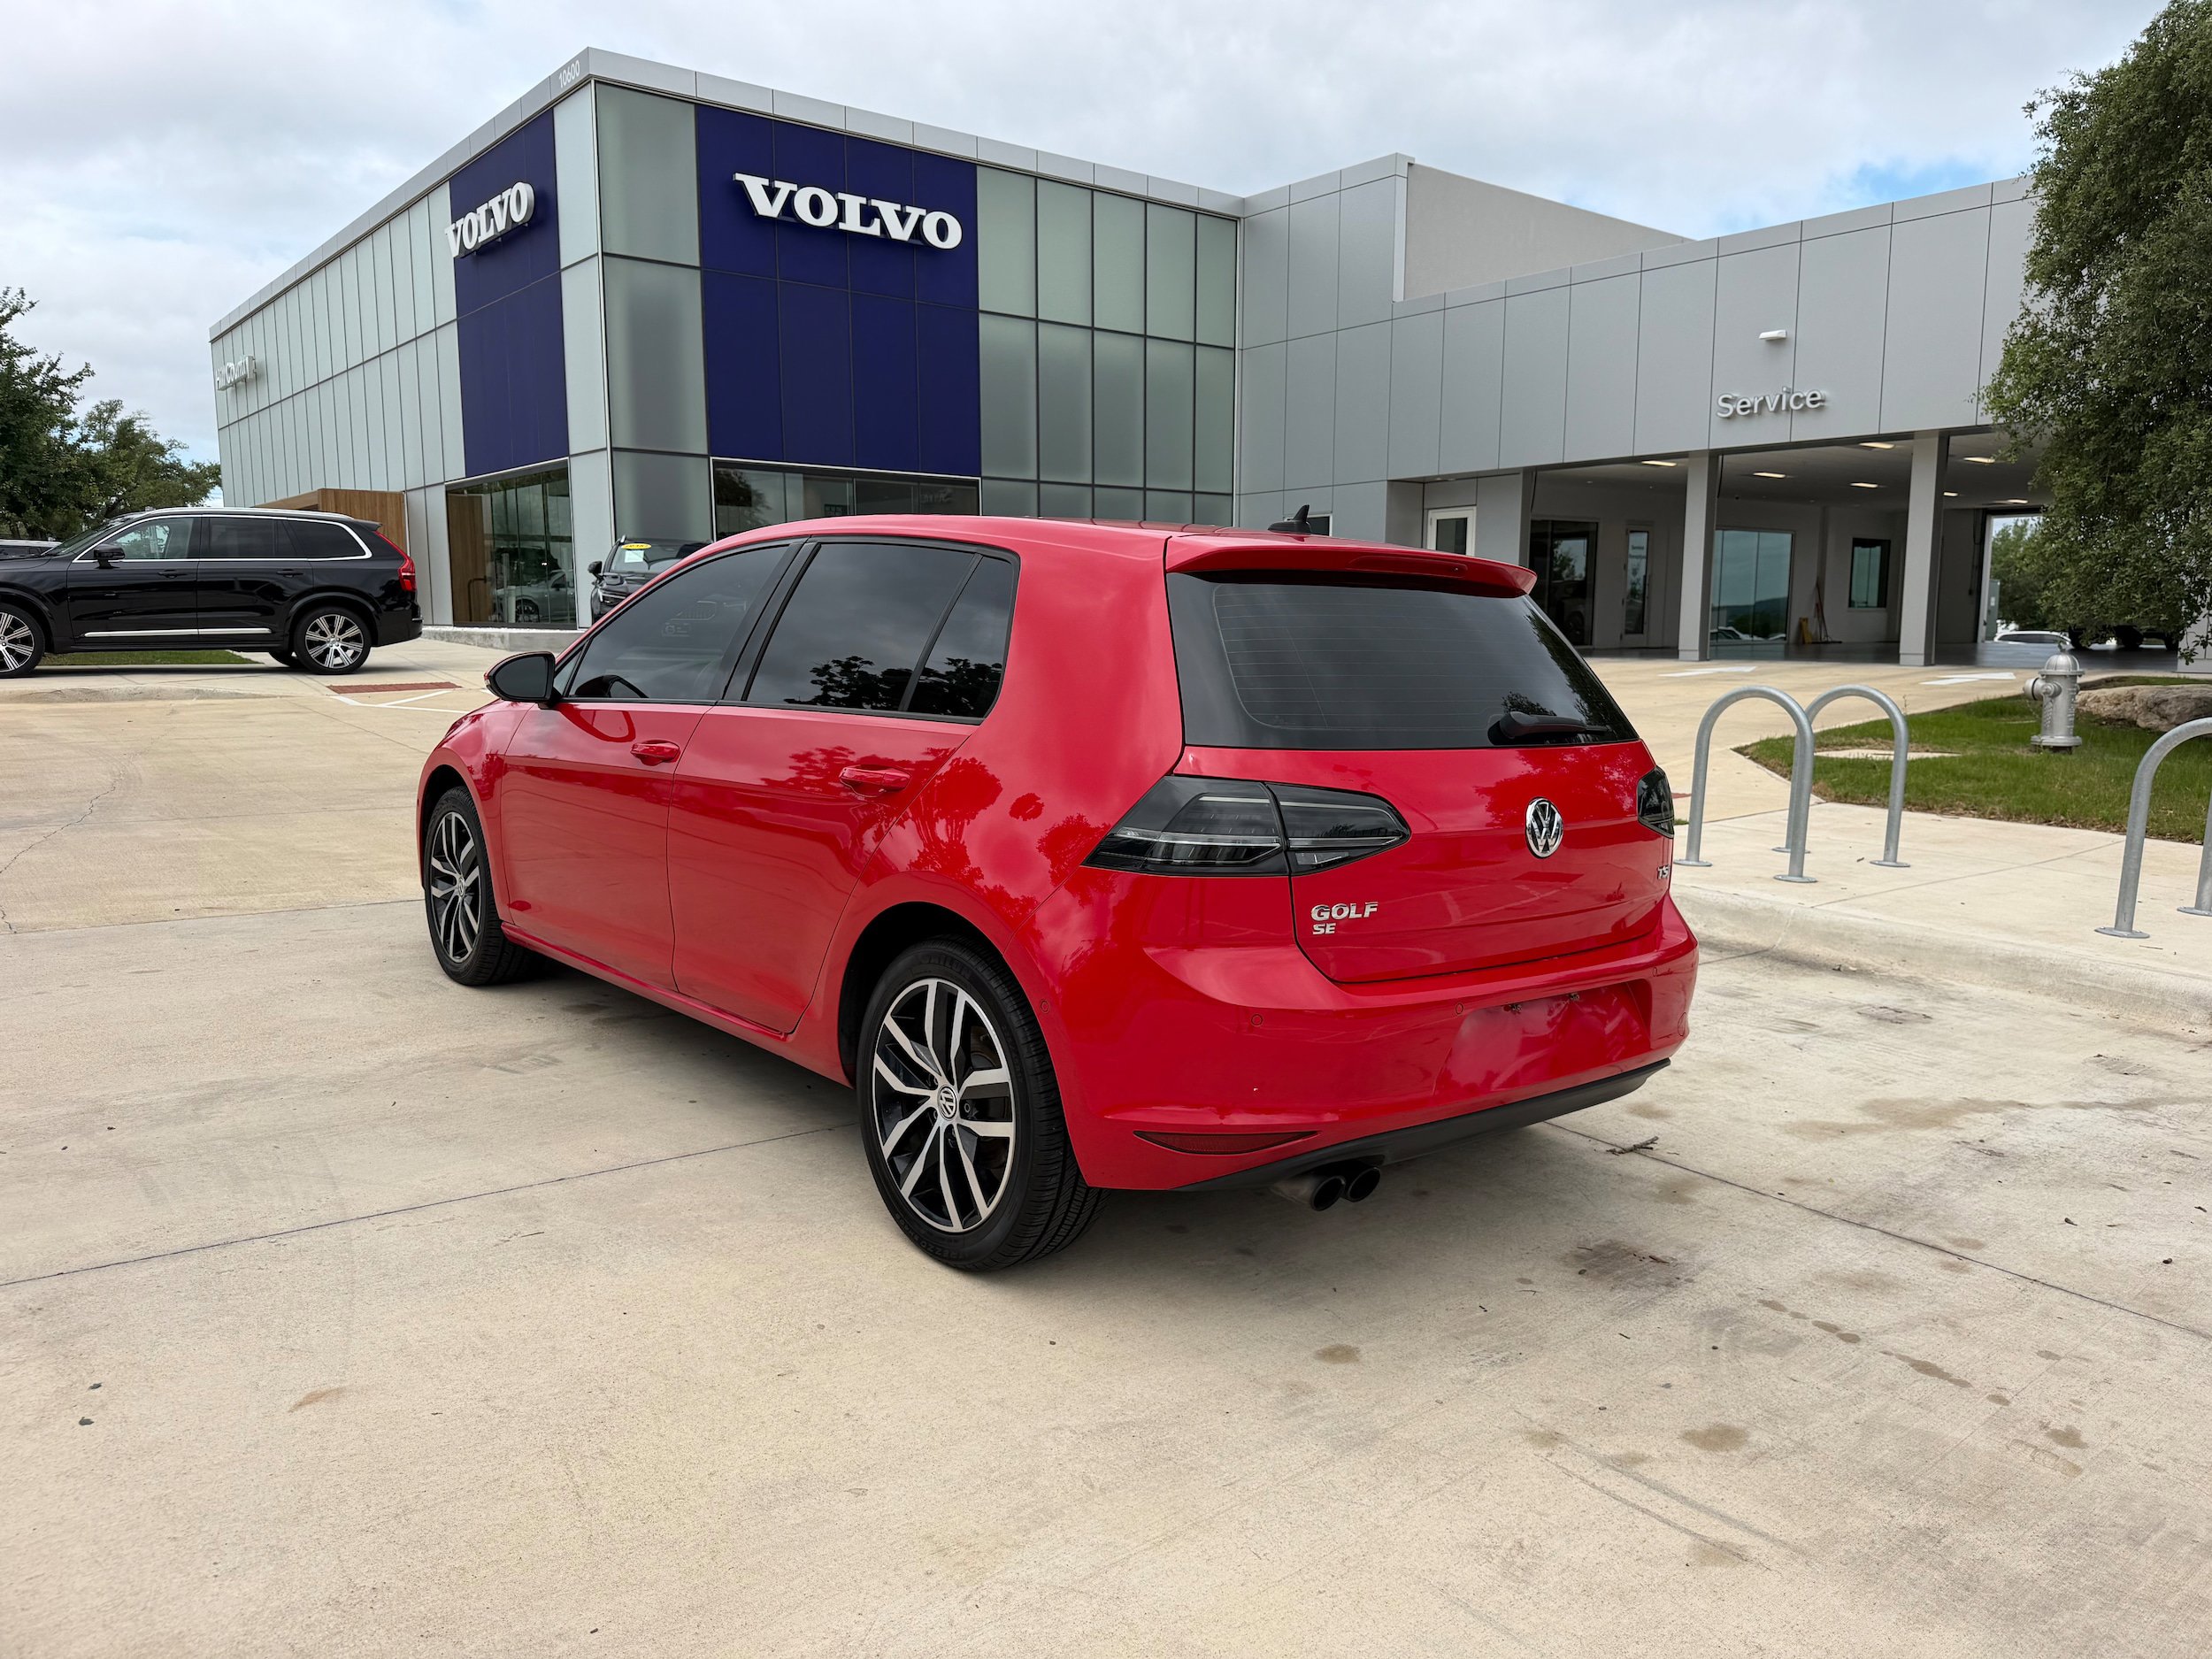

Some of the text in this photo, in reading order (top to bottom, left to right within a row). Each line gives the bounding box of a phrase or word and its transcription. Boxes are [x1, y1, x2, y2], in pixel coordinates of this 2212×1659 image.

[558, 59, 580, 88] 10600
[444, 181, 534, 258] VOLVO
[733, 173, 962, 250] VOLVO
[1717, 386, 1824, 418] Service
[1310, 901, 1379, 922] GOLF
[1312, 922, 1337, 935] SE
